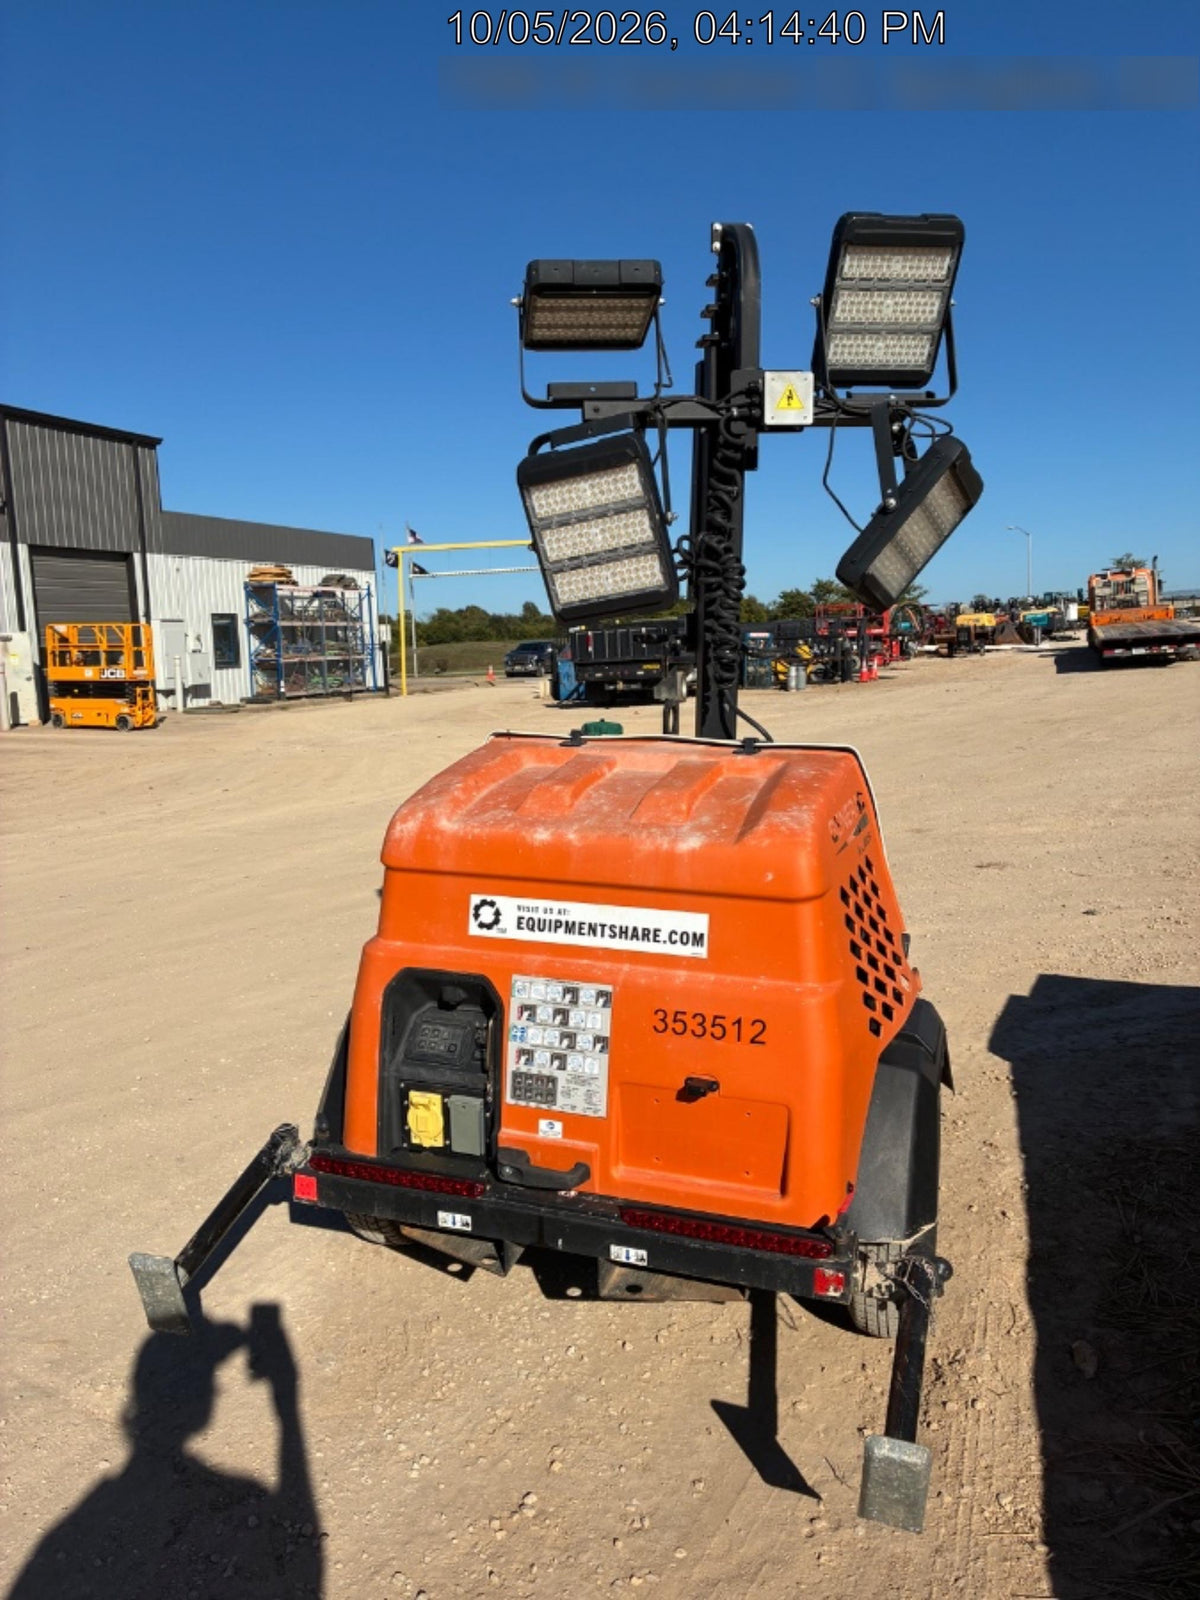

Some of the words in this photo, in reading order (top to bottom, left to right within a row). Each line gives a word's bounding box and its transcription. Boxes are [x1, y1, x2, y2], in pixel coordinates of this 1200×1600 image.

[101, 669, 126, 678] JCB
[517, 904, 539, 913] VISIT
[516, 916, 705, 948] EQUIPMENTSHARE.COM
[652, 1008, 767, 1045] 353512
